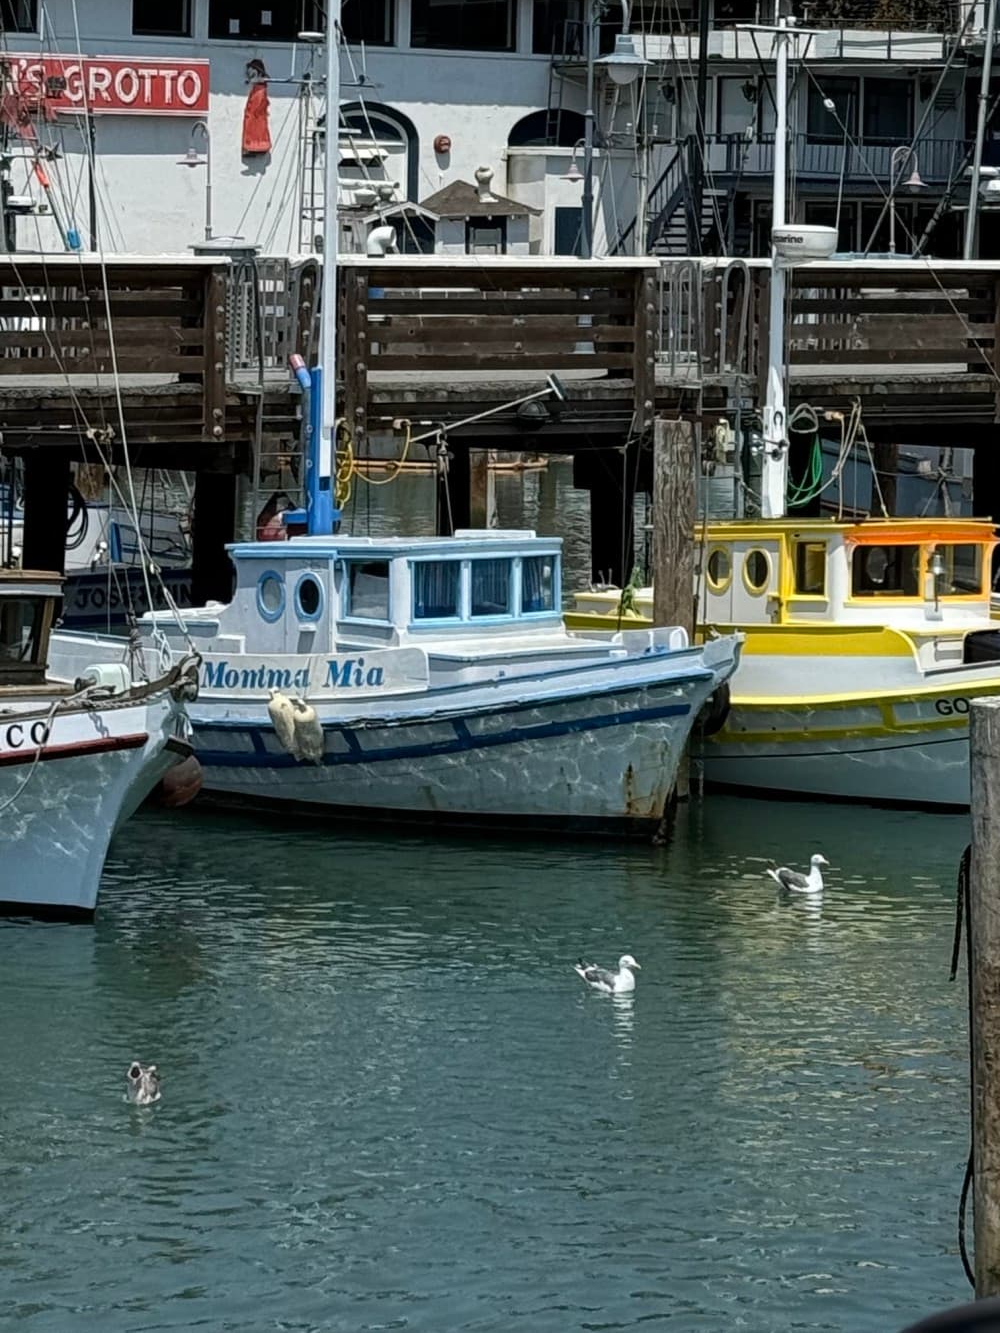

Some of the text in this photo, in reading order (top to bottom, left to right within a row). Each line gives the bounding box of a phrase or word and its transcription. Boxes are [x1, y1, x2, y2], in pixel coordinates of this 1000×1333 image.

[64, 65, 202, 106] GROTTO
[200, 657, 385, 688] Momma Mia
